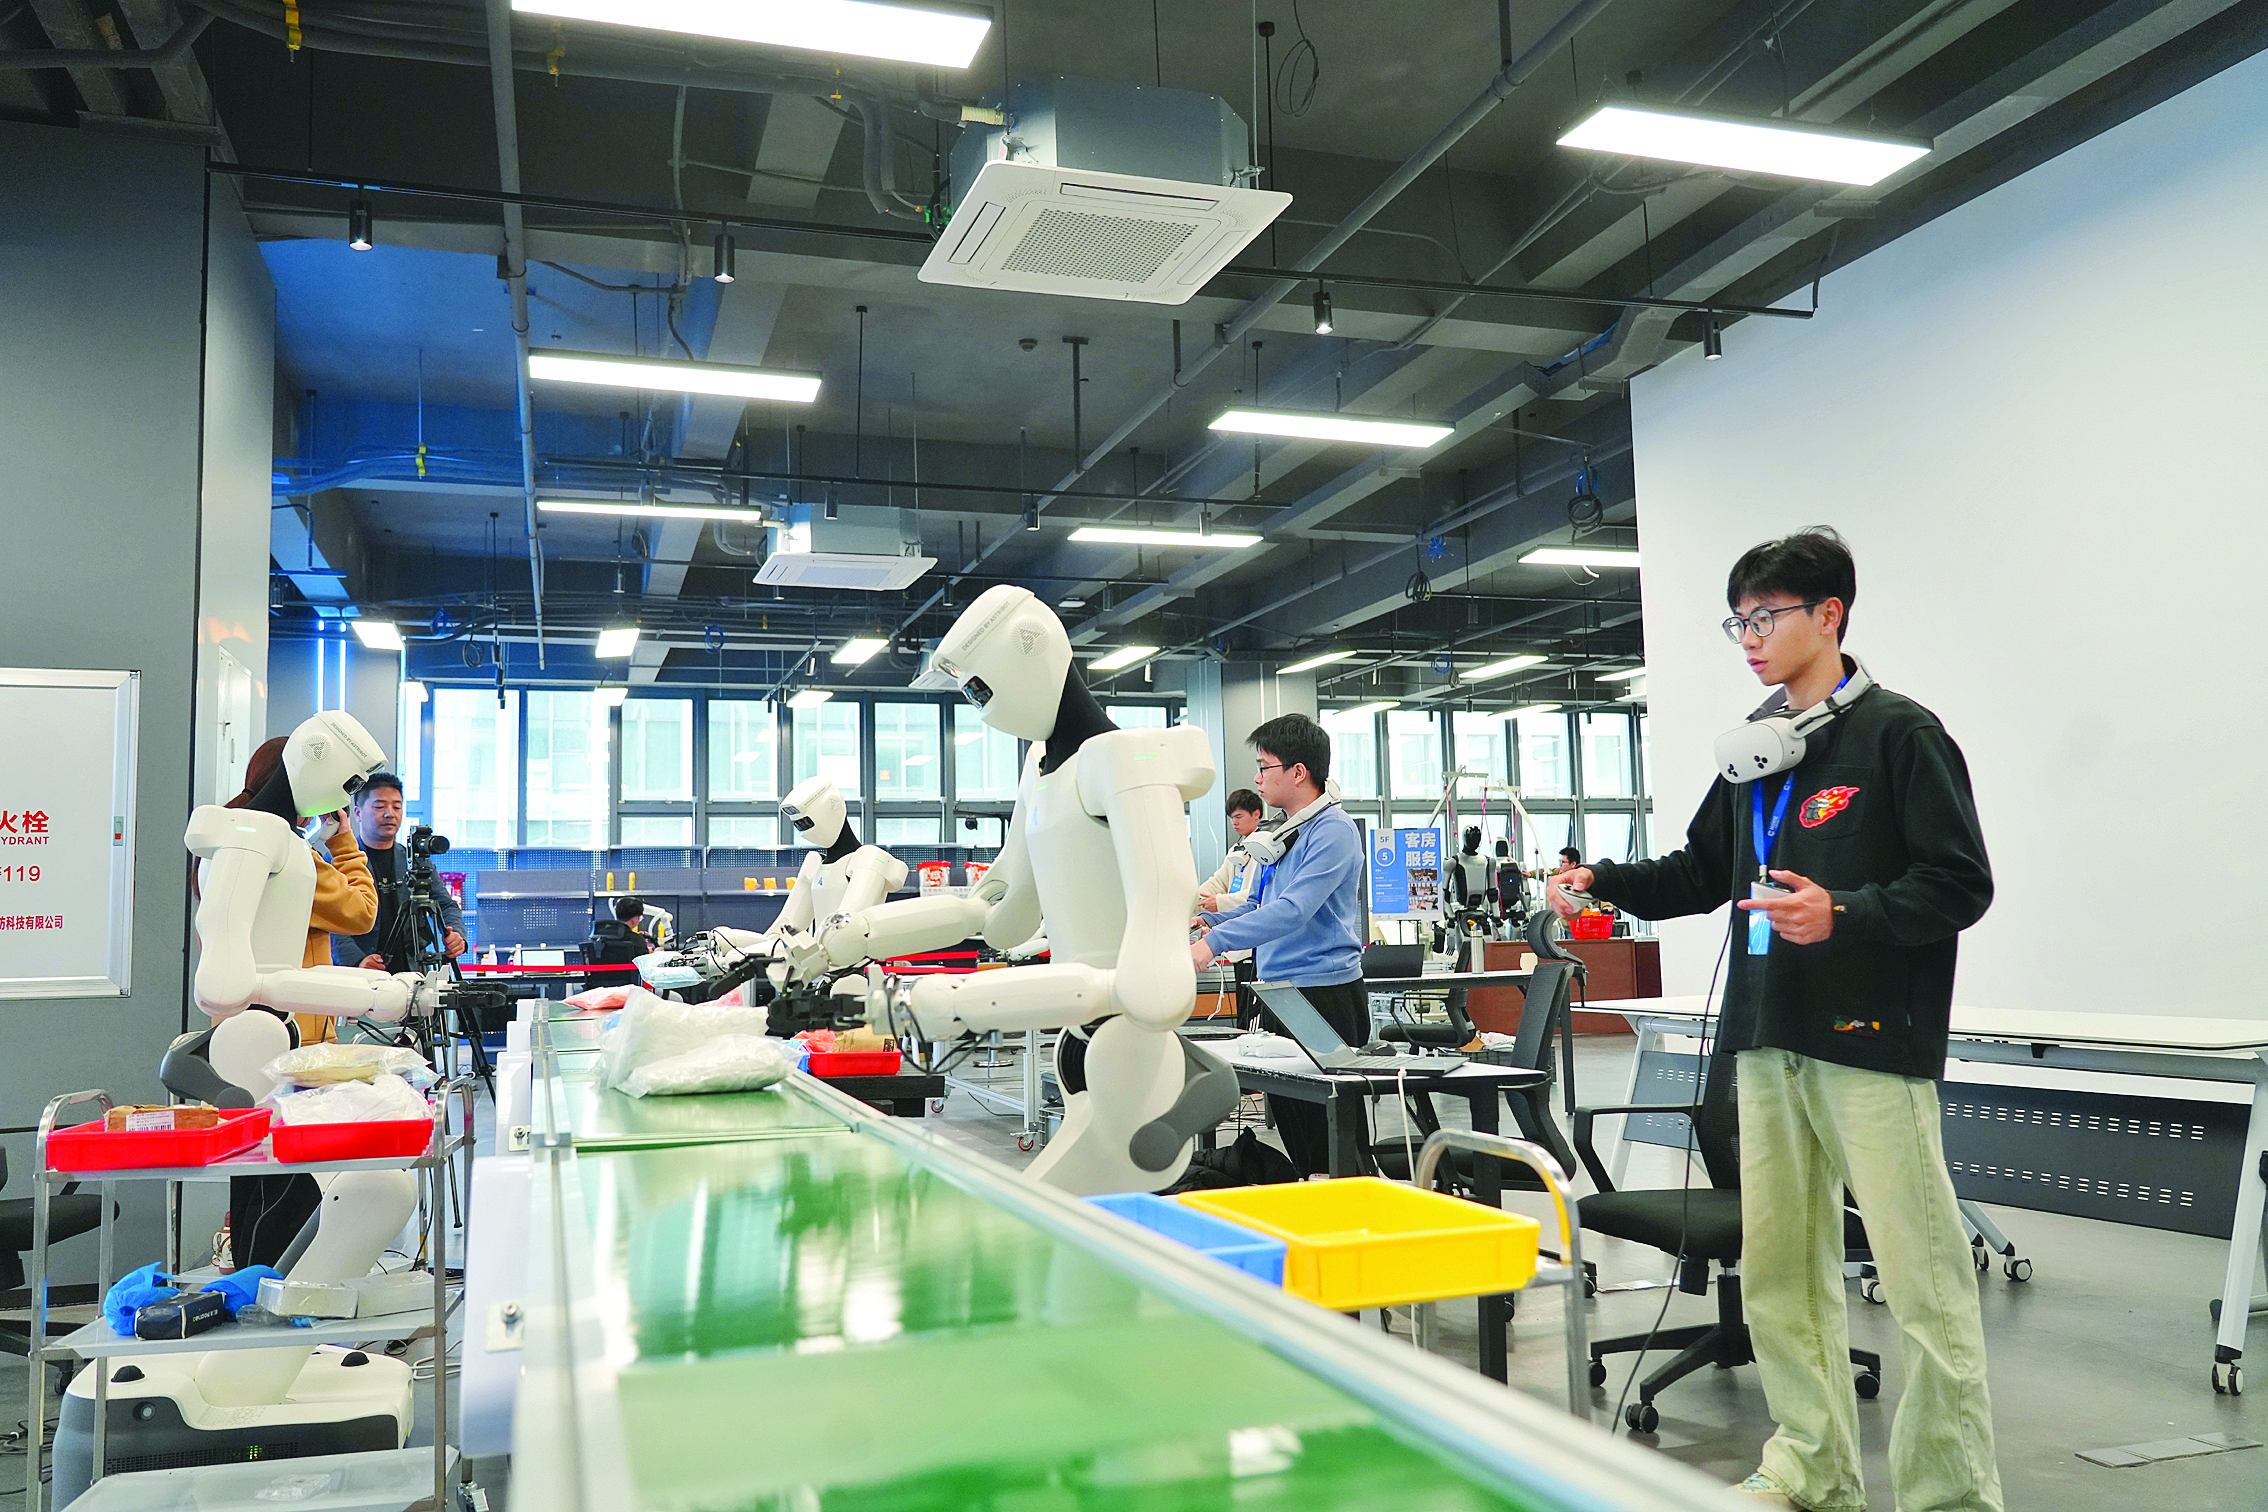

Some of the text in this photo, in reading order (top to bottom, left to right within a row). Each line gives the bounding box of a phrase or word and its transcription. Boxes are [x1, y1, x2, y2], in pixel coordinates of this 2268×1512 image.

[962, 627, 985, 651] DESIGNED
[983, 621, 991, 629] BY
[0, 810, 50, 833] 火栓
[0, 836, 50, 845] YDRANT
[1405, 832, 1436, 848] 客房
[1382, 852, 1388, 861] 5
[1405, 851, 1437, 867] 服务
[0, 865, 41, 882] 119
